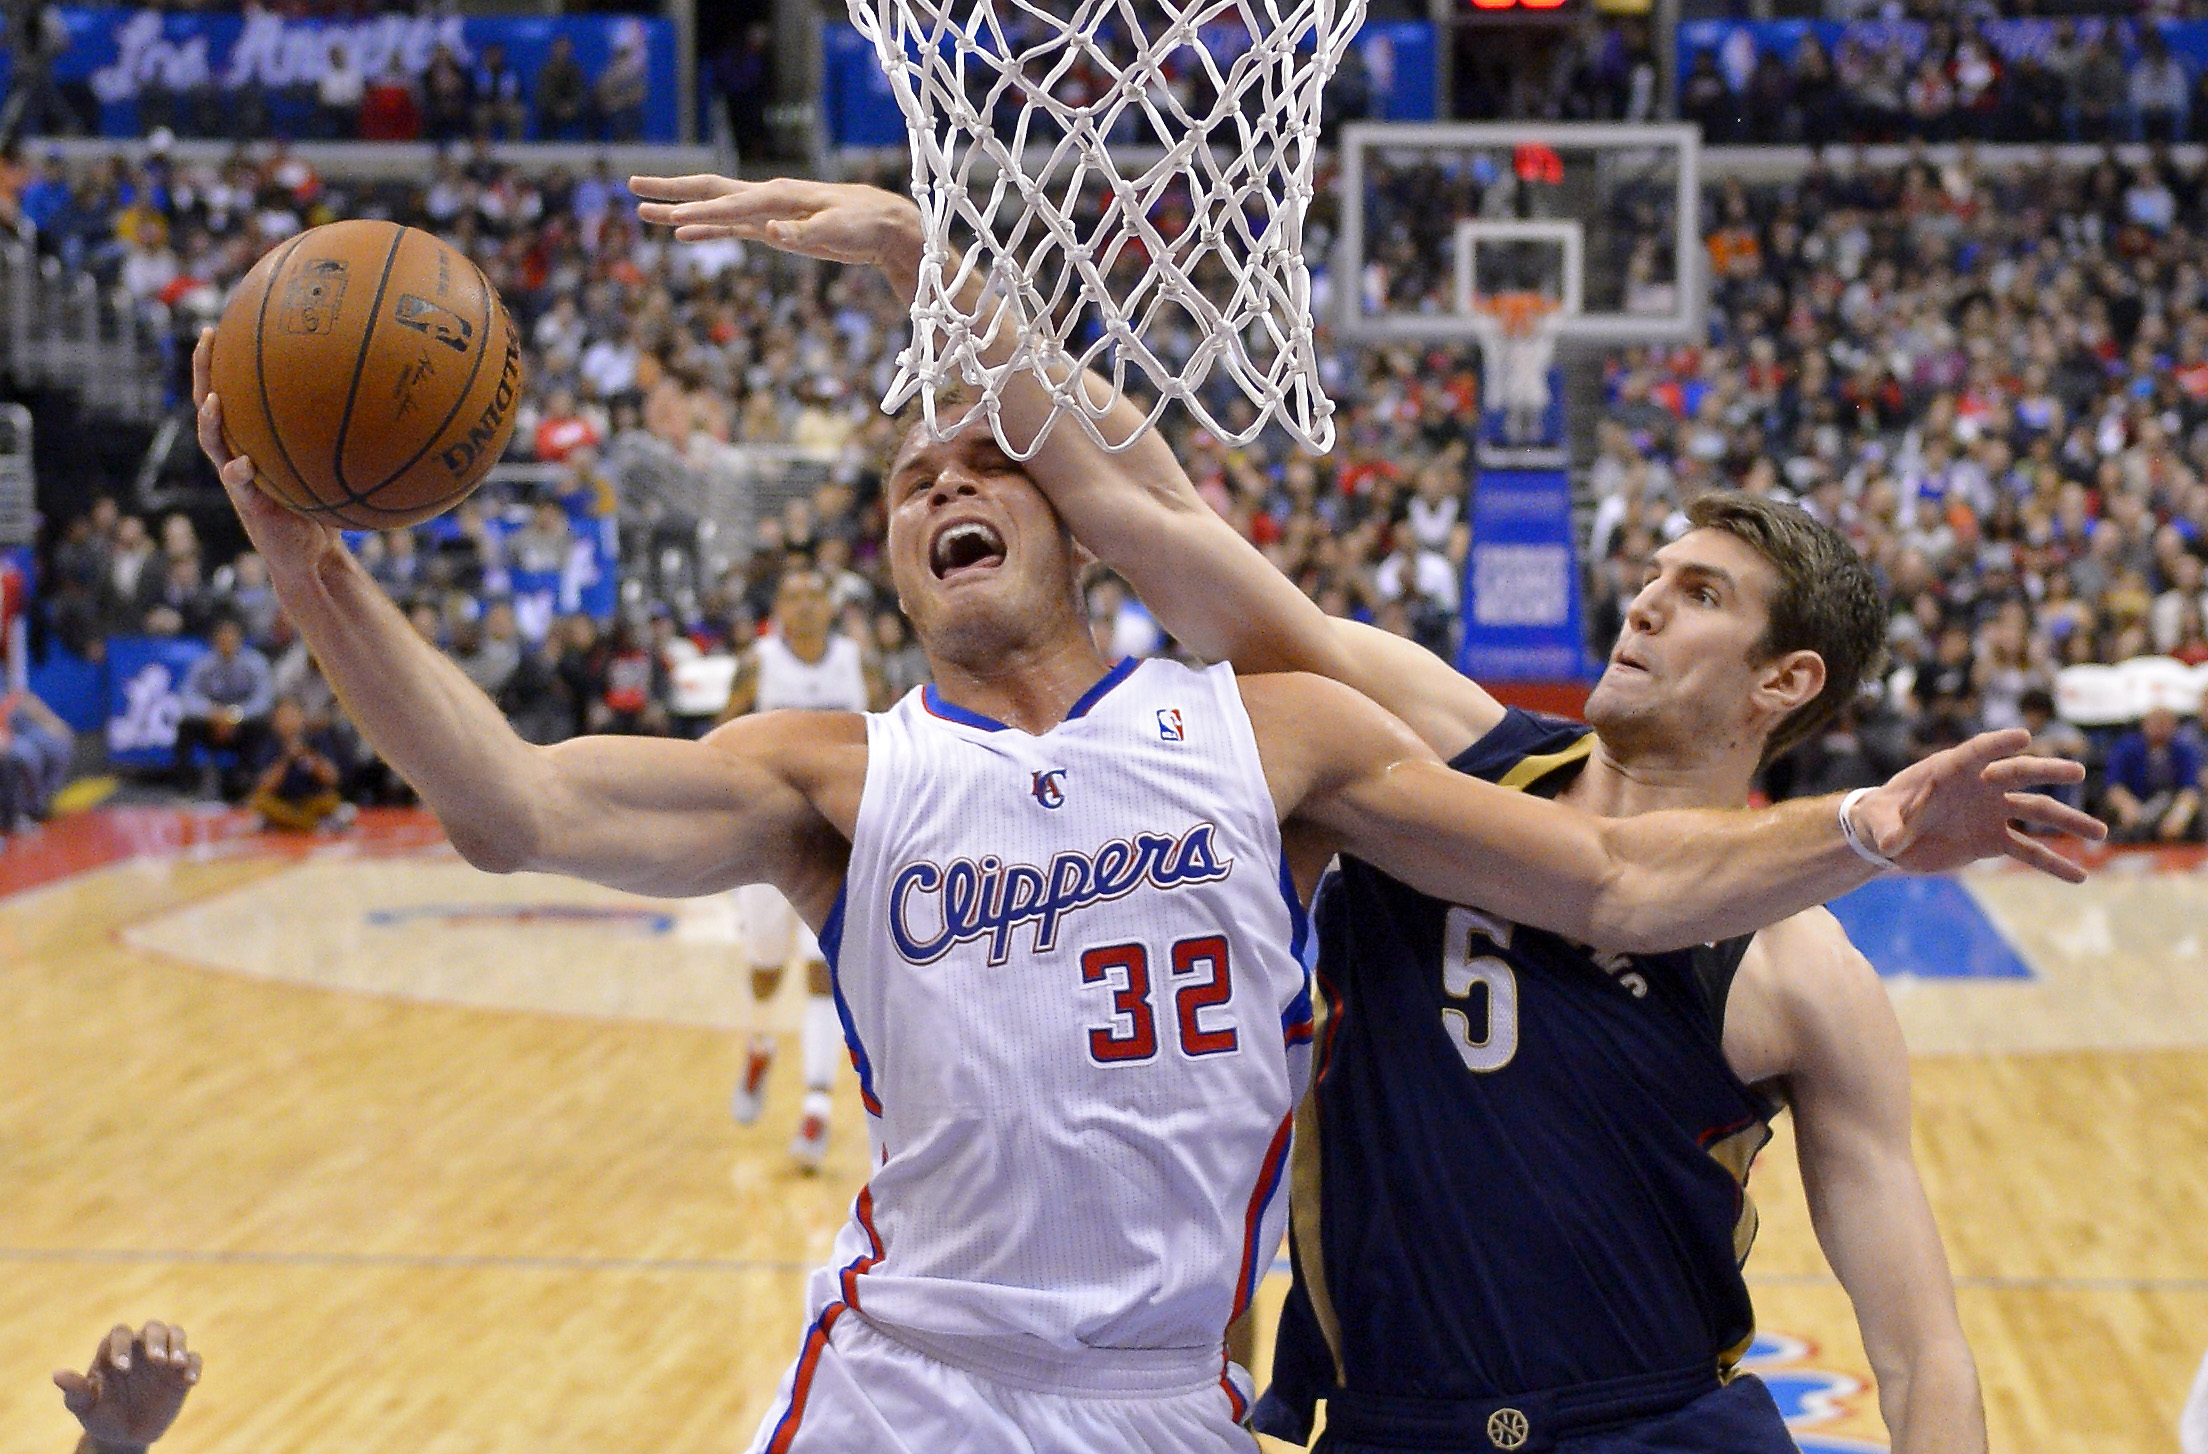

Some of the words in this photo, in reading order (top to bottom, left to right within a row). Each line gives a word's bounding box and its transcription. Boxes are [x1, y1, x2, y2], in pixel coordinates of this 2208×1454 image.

[888, 822, 1235, 968] Clippers
[1080, 934, 1240, 1069] 32
[1442, 905, 1518, 1074] 5
